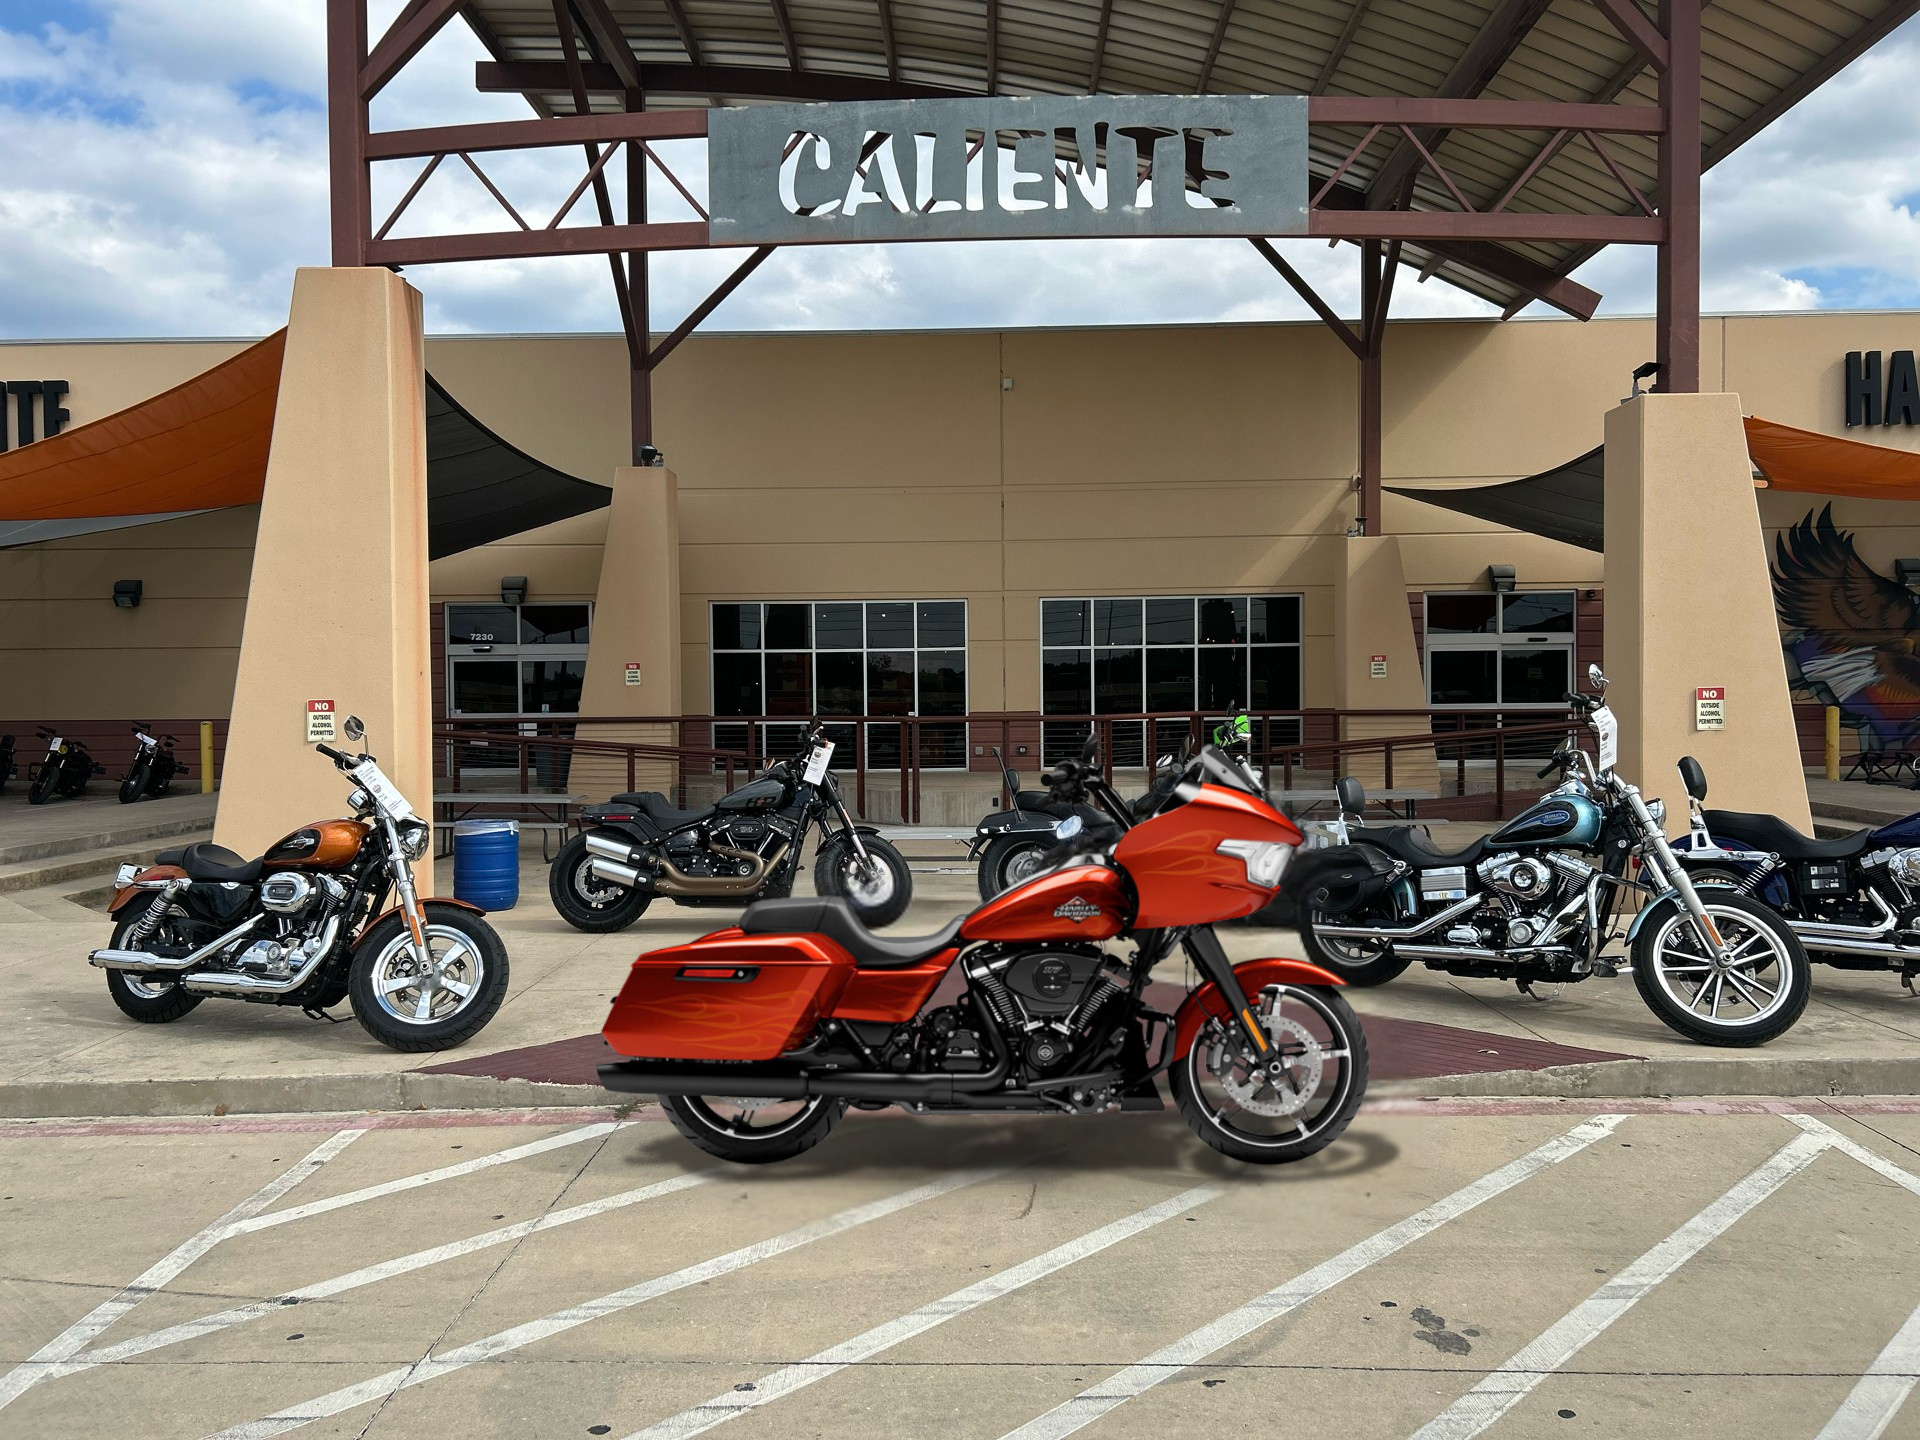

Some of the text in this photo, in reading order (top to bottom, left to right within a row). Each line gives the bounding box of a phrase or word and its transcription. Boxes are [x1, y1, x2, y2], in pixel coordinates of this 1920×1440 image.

[778, 122, 1236, 217] CALIENTE
[470, 633, 494, 641] 7230
[1702, 690, 1717, 699] NO
[314, 702, 329, 711] NO
